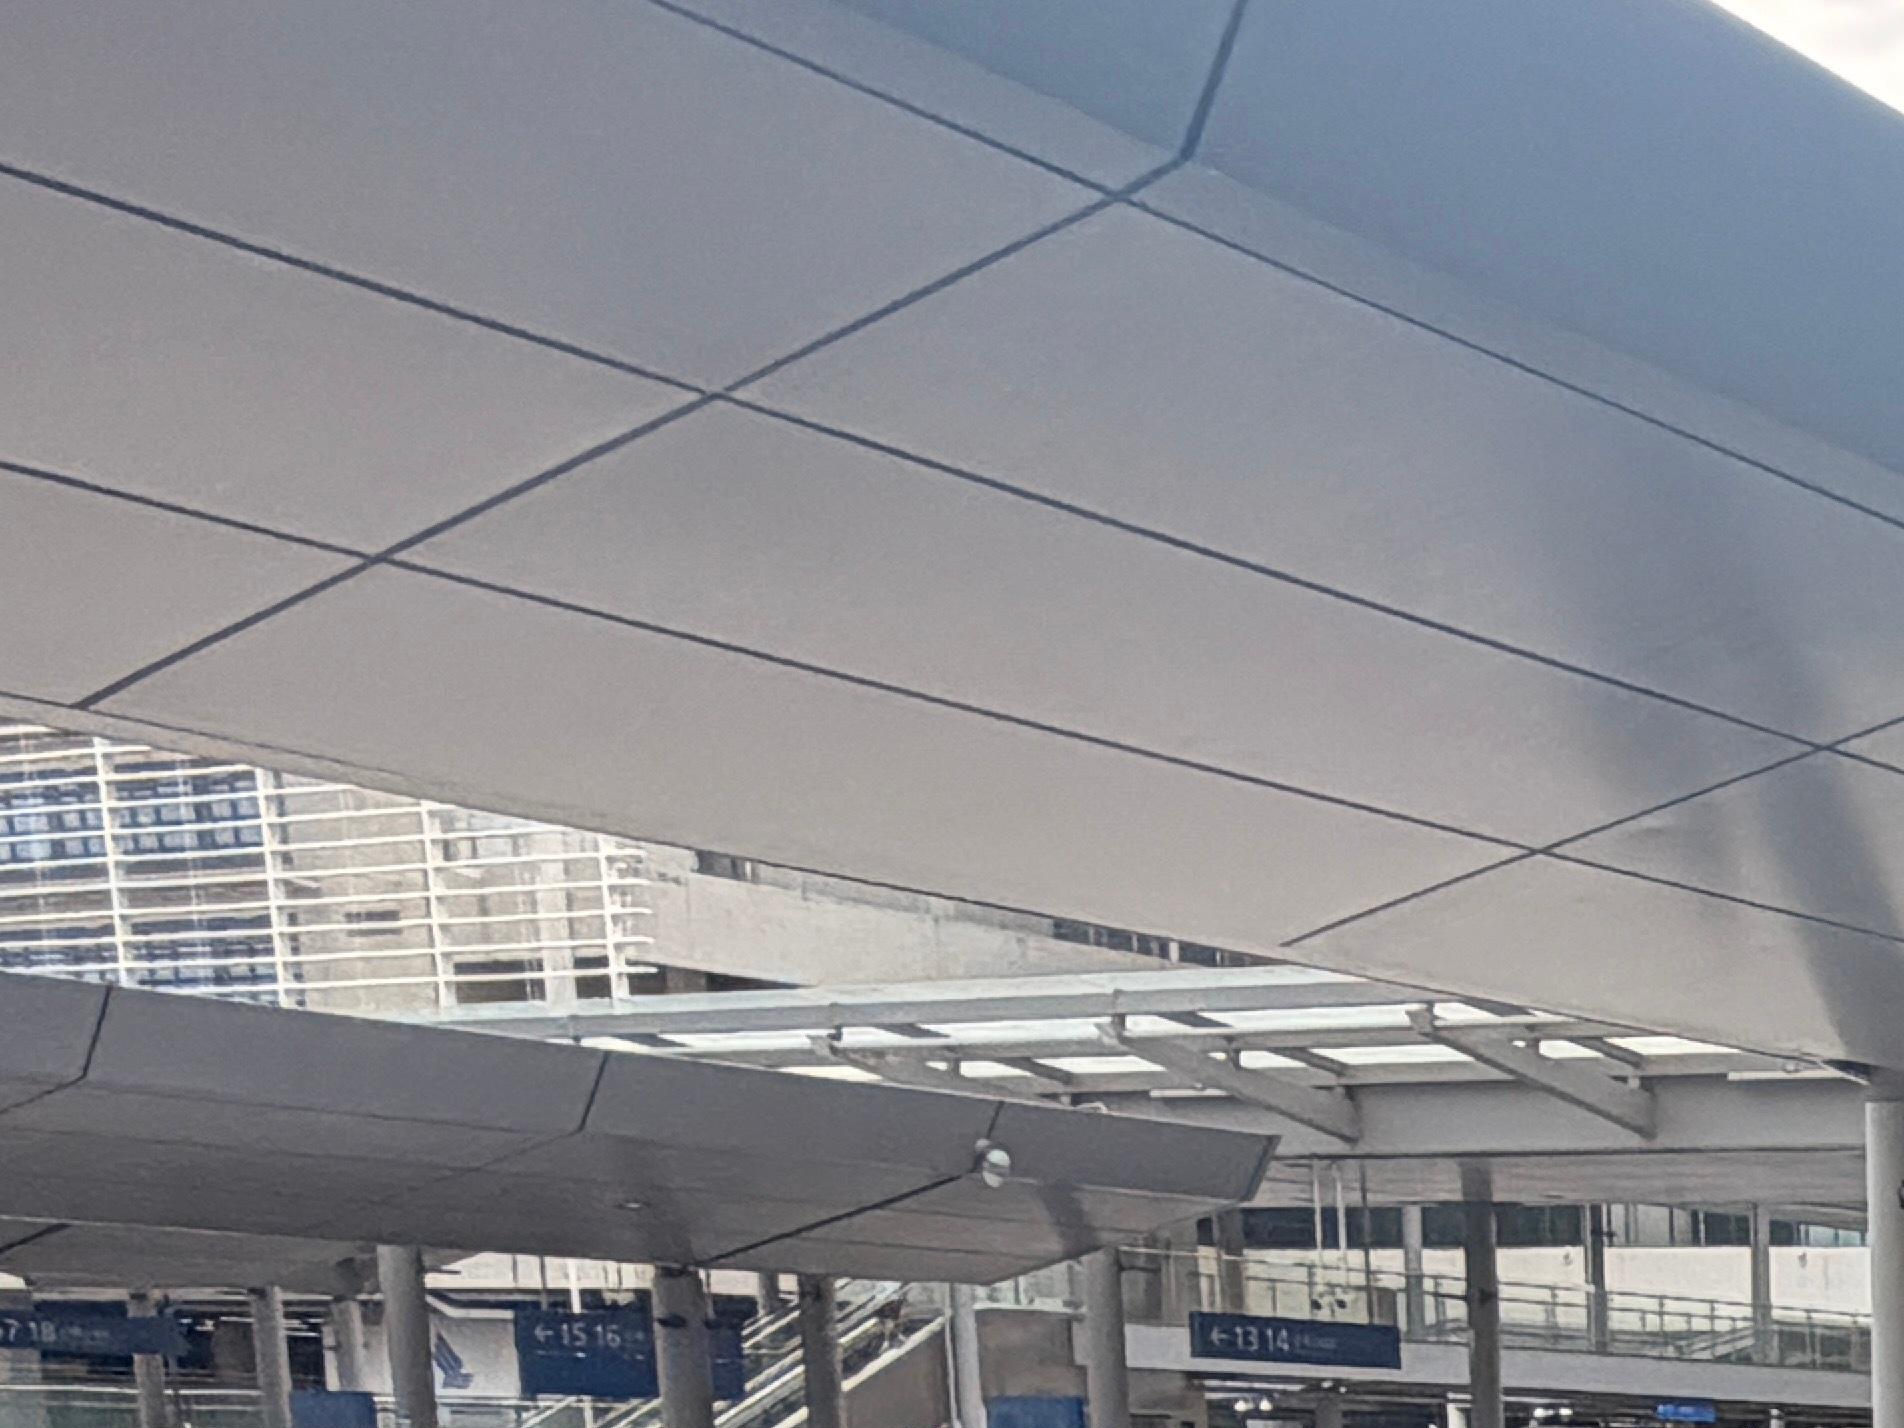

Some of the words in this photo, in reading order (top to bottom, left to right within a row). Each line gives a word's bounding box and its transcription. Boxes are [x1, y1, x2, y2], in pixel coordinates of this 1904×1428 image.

[560, 1322, 587, 1348] 15
[594, 1323, 621, 1349] 16
[1234, 1325, 1260, 1351] 13
[1265, 1327, 1290, 1352] 14
